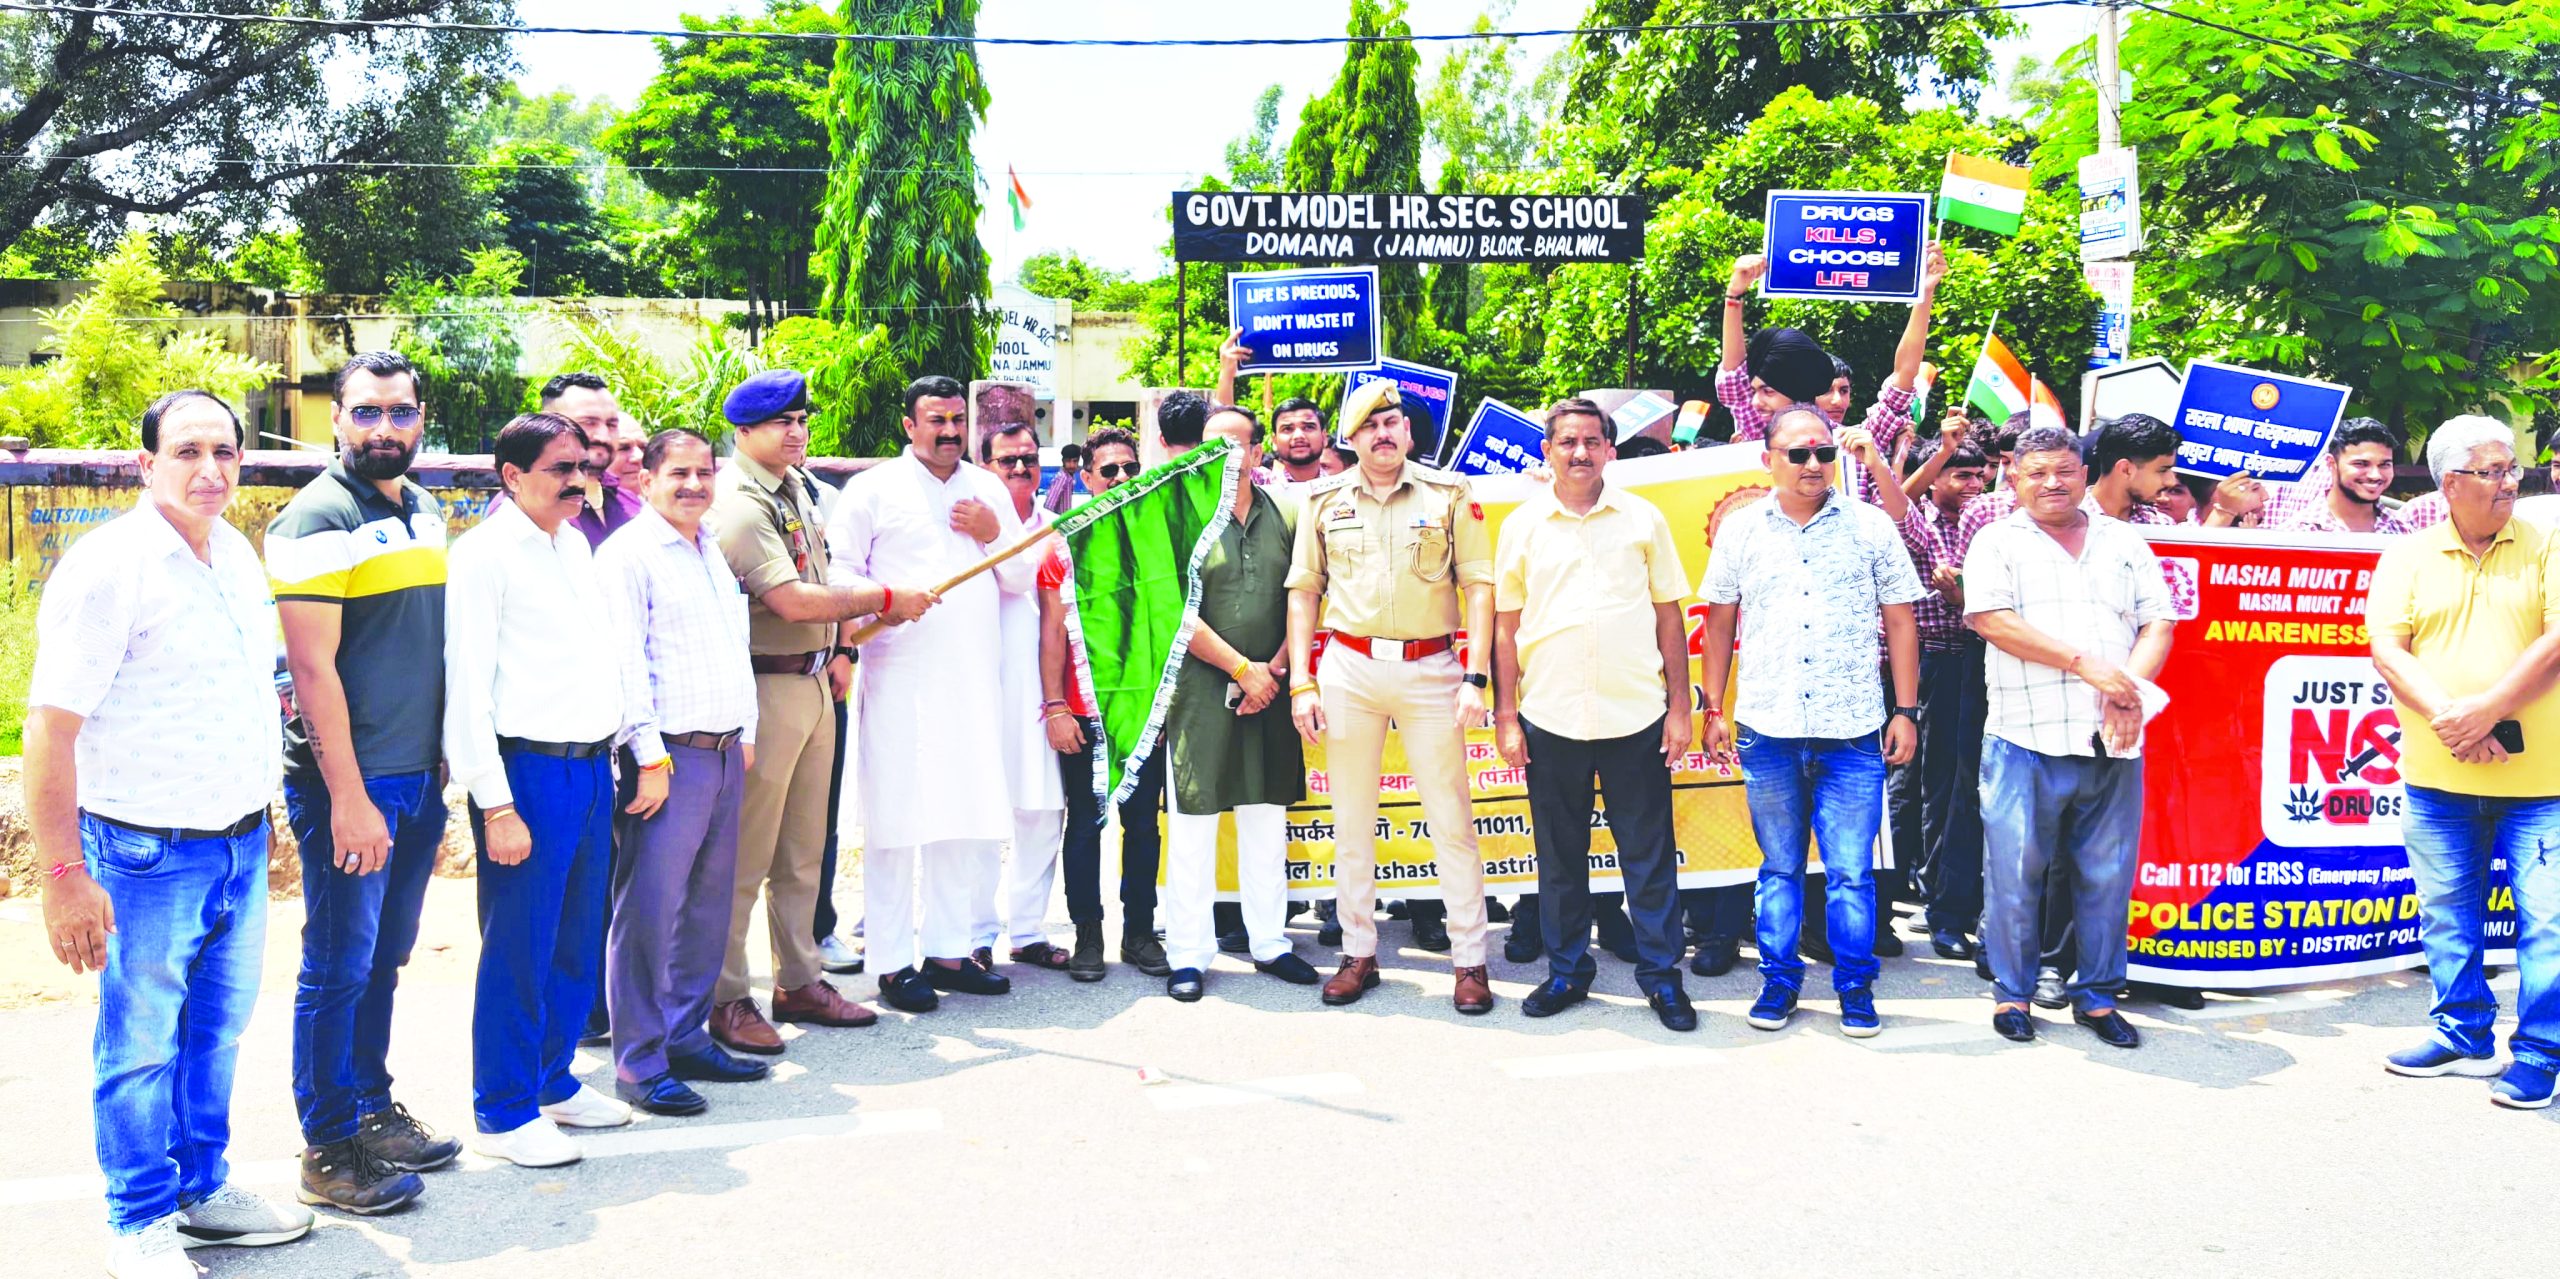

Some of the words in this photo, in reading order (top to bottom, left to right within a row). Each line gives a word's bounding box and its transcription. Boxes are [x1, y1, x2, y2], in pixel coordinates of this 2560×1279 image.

[1509, 197, 1628, 230] SCHOOL
[1801, 205, 1894, 222] DRUGS
[1246, 232, 1354, 258] DOMANA
[1374, 234, 1474, 259] (JAMMU)
[1788, 249, 1900, 267] CHOOSE
[1816, 271, 1869, 287] LIFE
[1246, 287, 1274, 304] LIFE
[1276, 286, 1290, 302] IS
[1292, 284, 1360, 301] PRECIOUS,
[1253, 314, 1294, 331] DON'T
[1295, 313, 1340, 329] WASTE
[1342, 312, 1355, 327] IT
[1272, 343, 1292, 358] ON
[1294, 341, 1339, 357] DRUGS
[1400, 380, 1447, 401] DRUGS
[2209, 563, 2281, 587] NASHA
[2287, 567, 2352, 590] MUKT
[2239, 592, 2292, 612] NASHA
[2296, 595, 2342, 614] MUKT
[2205, 620, 2371, 645] AWARENESS
[2293, 681, 2364, 704] JUST
[2289, 708, 2401, 785] NO
[2294, 801, 2314, 816] TO
[2329, 795, 2401, 817] DRUGS
[2140, 862, 2181, 887] Call
[2188, 862, 2221, 887] 112
[2225, 862, 2251, 886] for
[2255, 861, 2304, 885] ERSS
[2308, 867, 2380, 886] (Emergency
[2128, 899, 2255, 930] POLICE
[2264, 896, 2394, 929] STATION
[2260, 938, 2286, 957] BY
[2302, 931, 2384, 954] DISTRICT
